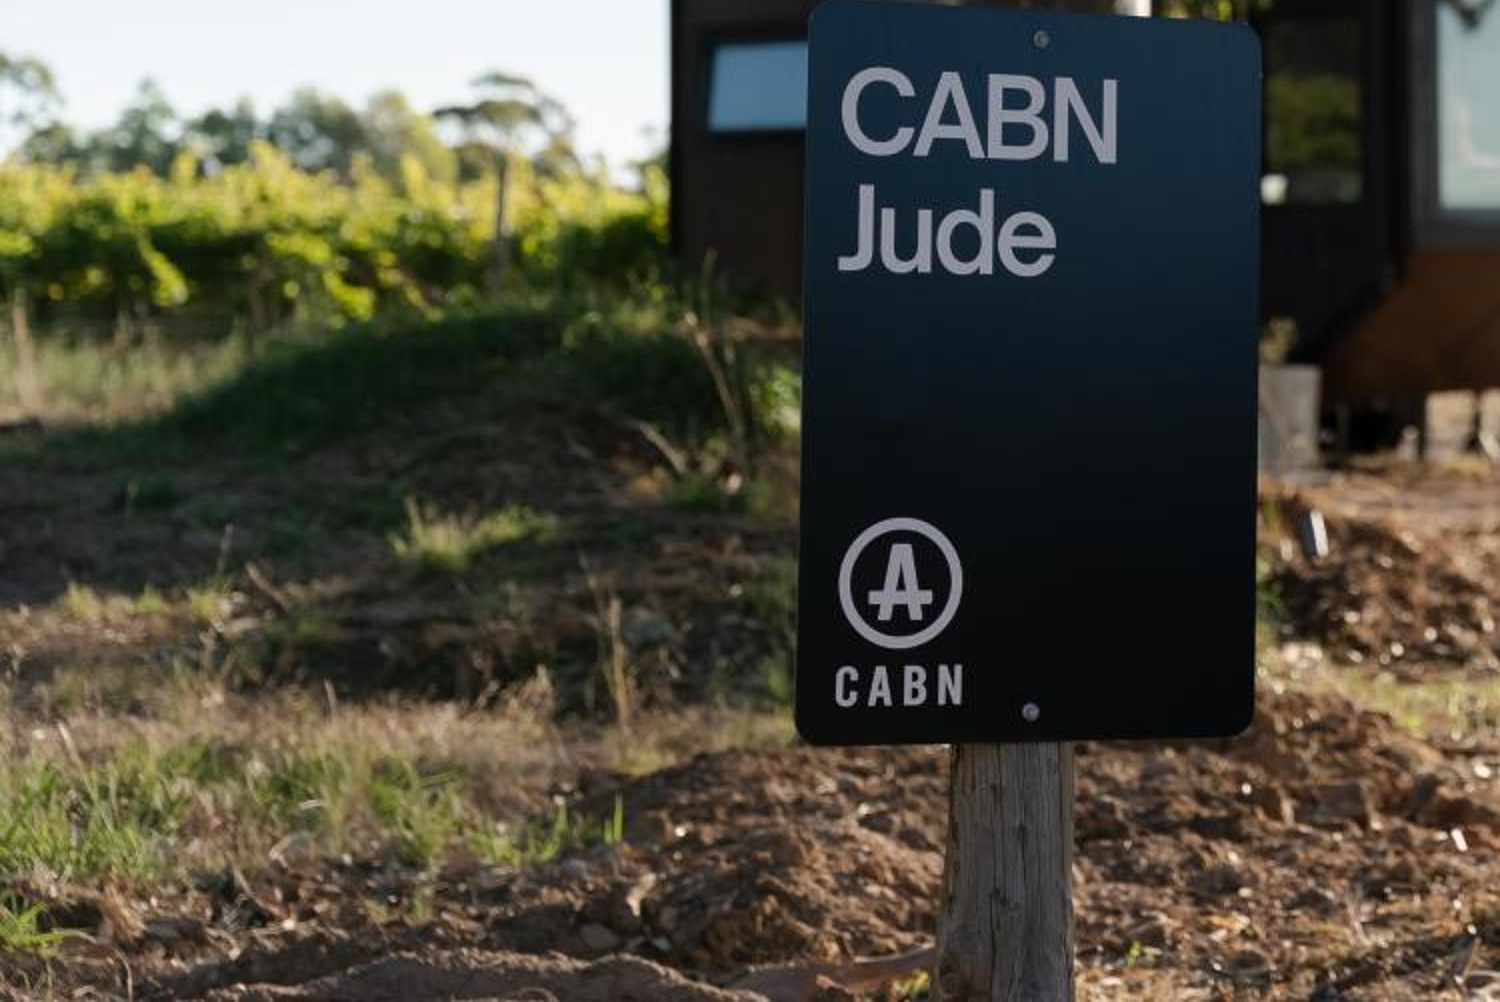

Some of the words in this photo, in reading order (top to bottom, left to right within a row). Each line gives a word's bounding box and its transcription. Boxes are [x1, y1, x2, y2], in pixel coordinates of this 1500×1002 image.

[841, 66, 1118, 164] CABN
[838, 184, 1057, 277] Jude
[835, 664, 963, 707] CABN
